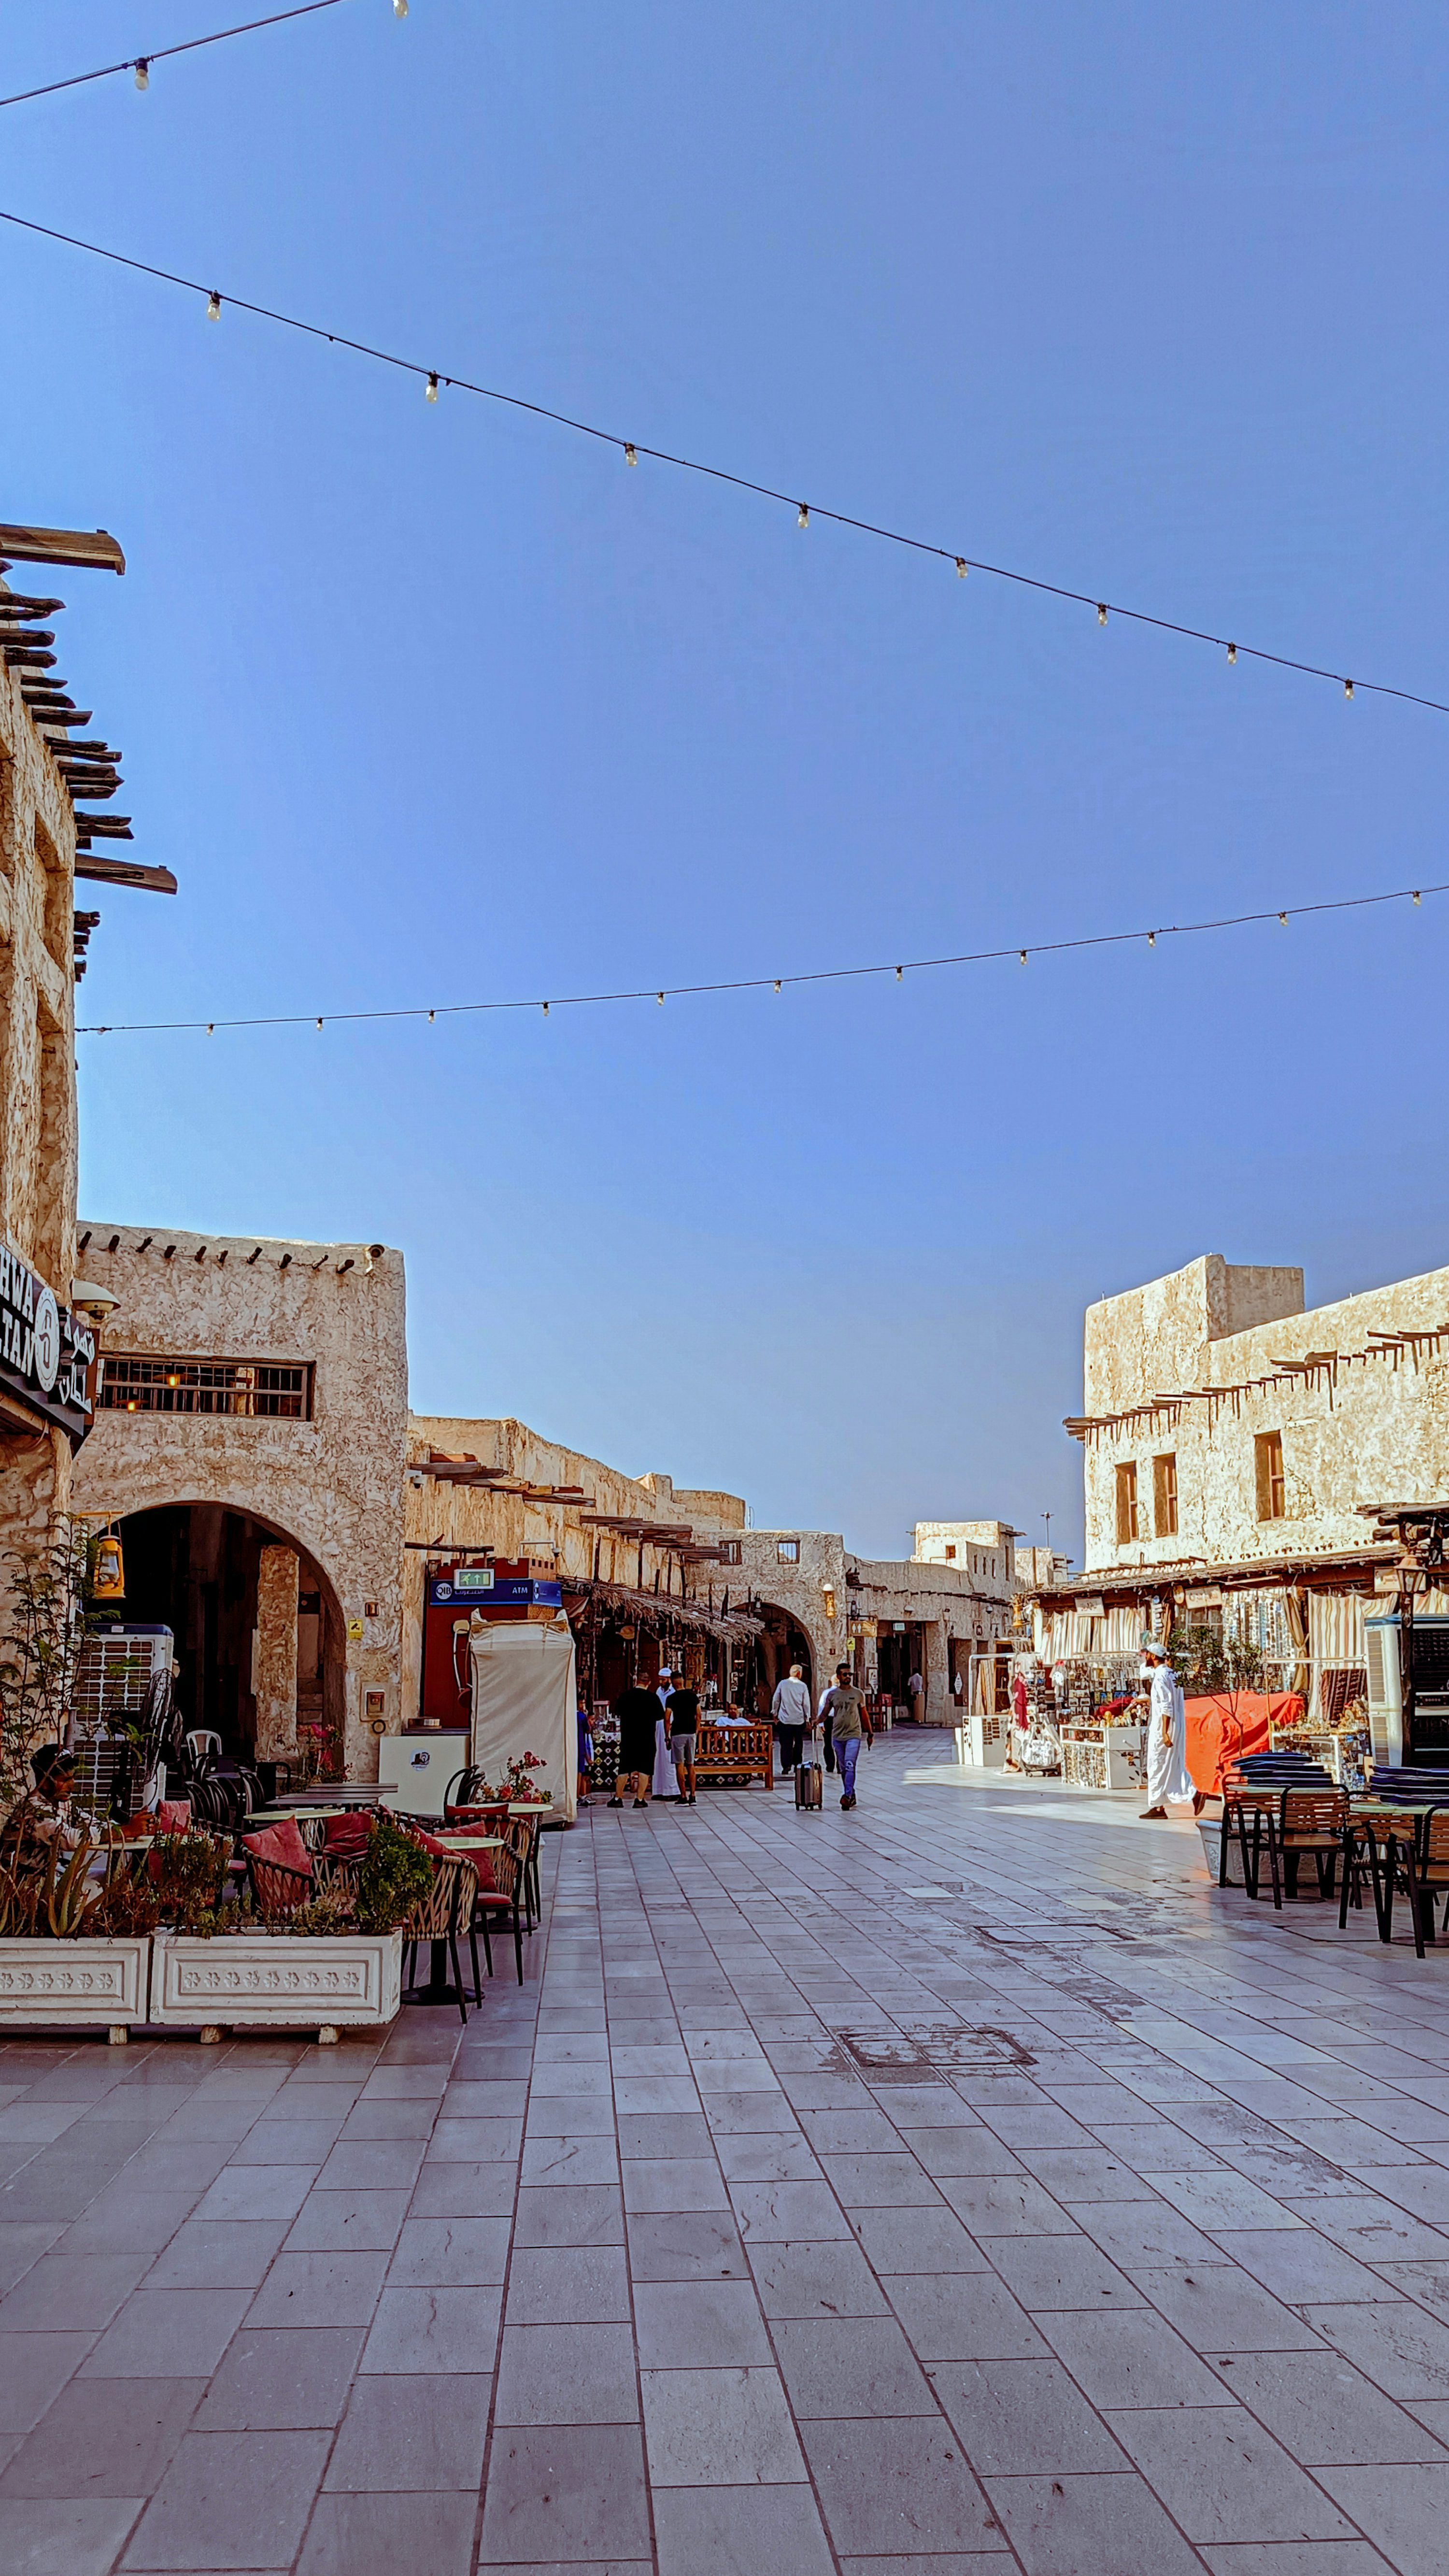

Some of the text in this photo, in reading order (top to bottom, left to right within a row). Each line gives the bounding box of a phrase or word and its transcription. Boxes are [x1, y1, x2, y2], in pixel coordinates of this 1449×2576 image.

[0, 1308, 36, 1377] TAN
[64, 1305, 95, 1366] قهوة
[59, 1362, 92, 1414] سلطان
[436, 1587, 452, 1595] QIB
